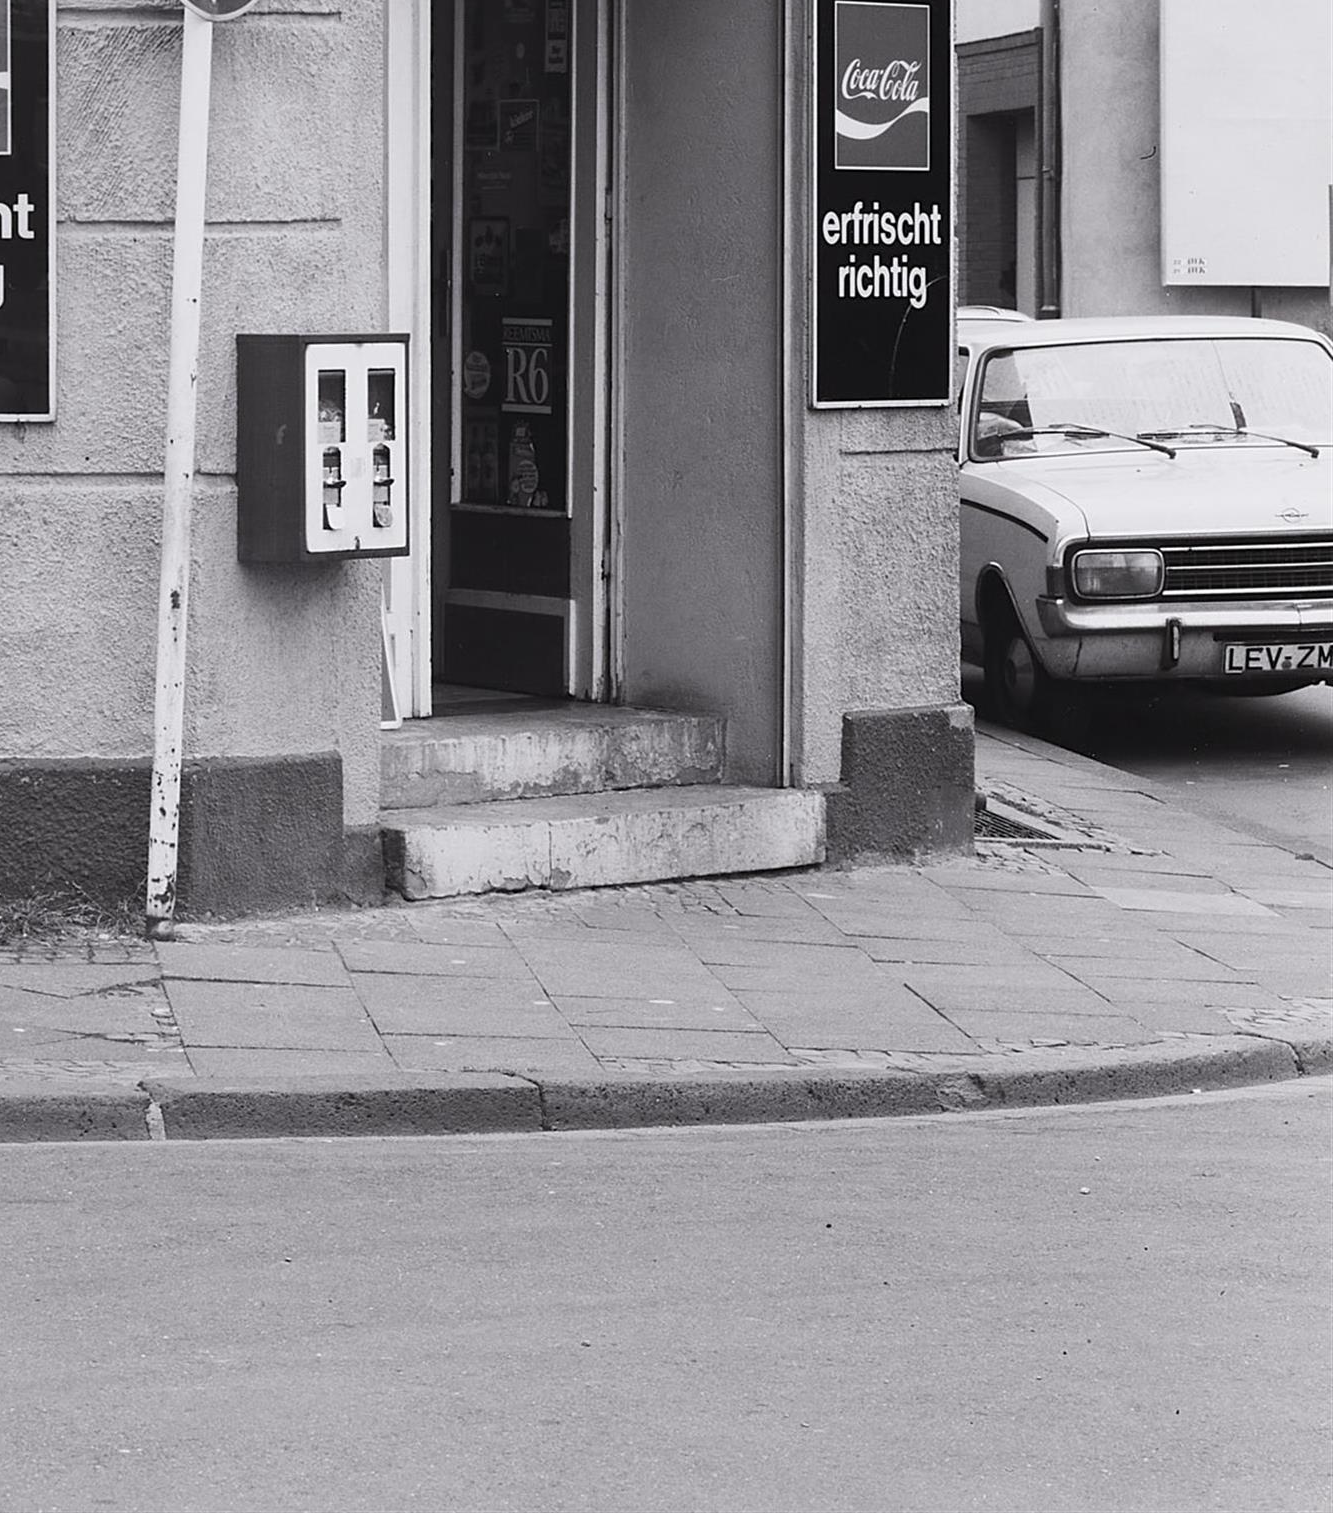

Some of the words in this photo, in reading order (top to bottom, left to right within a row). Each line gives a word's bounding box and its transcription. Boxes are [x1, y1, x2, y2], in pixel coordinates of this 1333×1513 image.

[842, 57, 921, 101] Coca-Cola
[822, 201, 942, 246] erfrischt
[838, 255, 928, 309] richtig
[505, 347, 549, 404] R6
